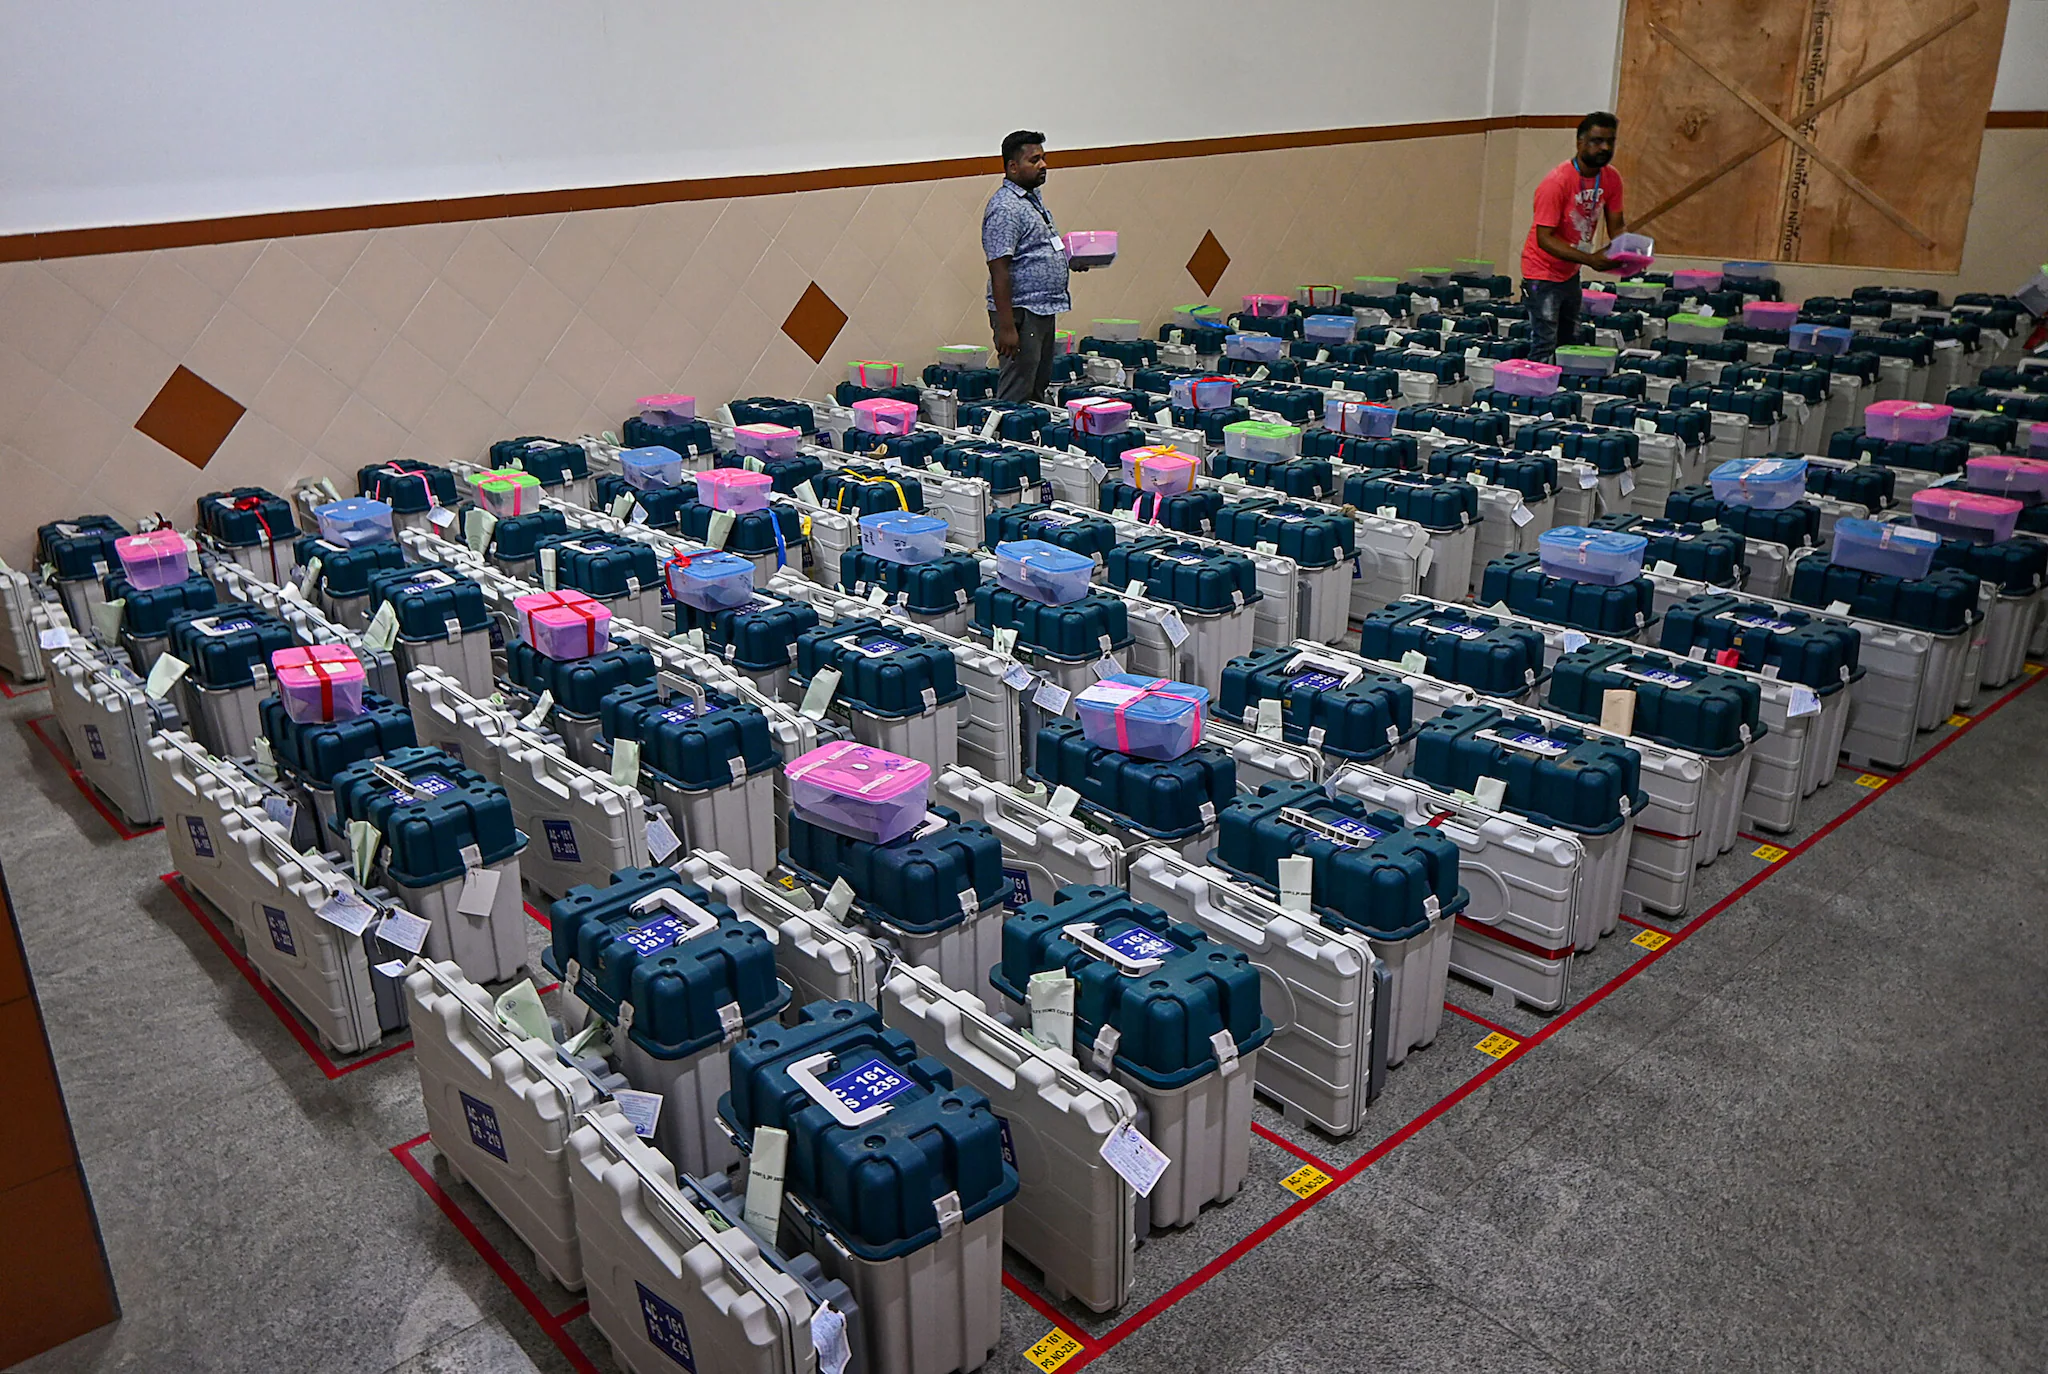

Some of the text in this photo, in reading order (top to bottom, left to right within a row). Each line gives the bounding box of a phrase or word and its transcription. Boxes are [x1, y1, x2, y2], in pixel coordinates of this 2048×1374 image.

[1807, 48, 1822, 91] Nimra
[1791, 158, 1806, 200] Nimra
[1783, 211, 1798, 252] Nimra
[560, 829, 573, 841] 161
[1011, 877, 1026, 891] 61
[637, 936, 666, 952] 161
[1123, 932, 1150, 946] 161
[855, 1065, 888, 1086] 161
[866, 1075, 901, 1097] 235
[644, 1299, 658, 1321] AC
[665, 1314, 685, 1339] 161
[648, 1318, 664, 1341] PS
[669, 1334, 690, 1360] 235
[1046, 1333, 1062, 1346] 161
[1041, 1358, 1055, 1370] PS
